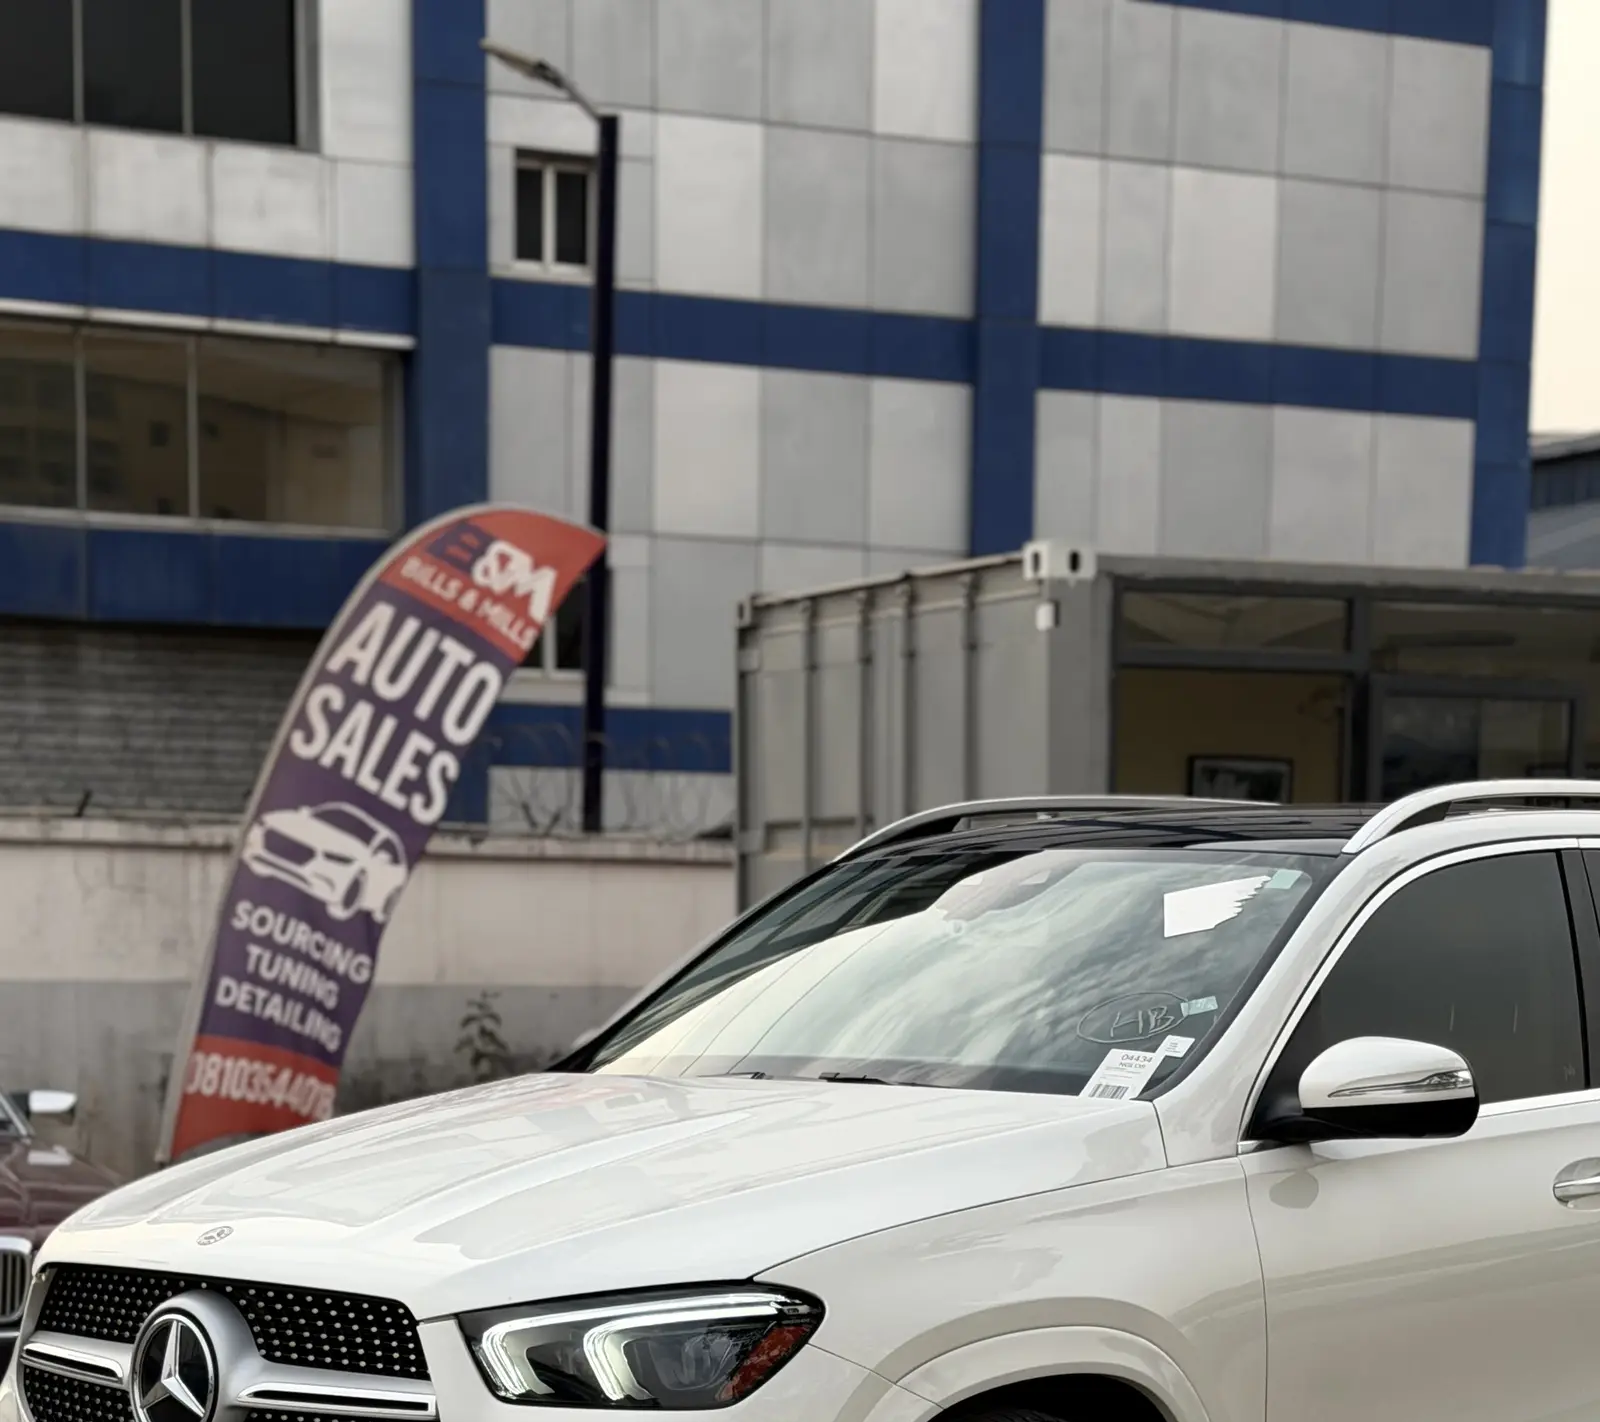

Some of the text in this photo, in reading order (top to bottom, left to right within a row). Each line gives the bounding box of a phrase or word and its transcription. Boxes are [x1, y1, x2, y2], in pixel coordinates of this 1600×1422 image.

[400, 556, 539, 652] BILLS & MILLS
[326, 601, 503, 746] AUTO
[289, 683, 460, 826] SALES
[231, 900, 373, 985] SOURCING
[246, 944, 340, 1010] TUNING
[215, 976, 343, 1053] DETAILING
